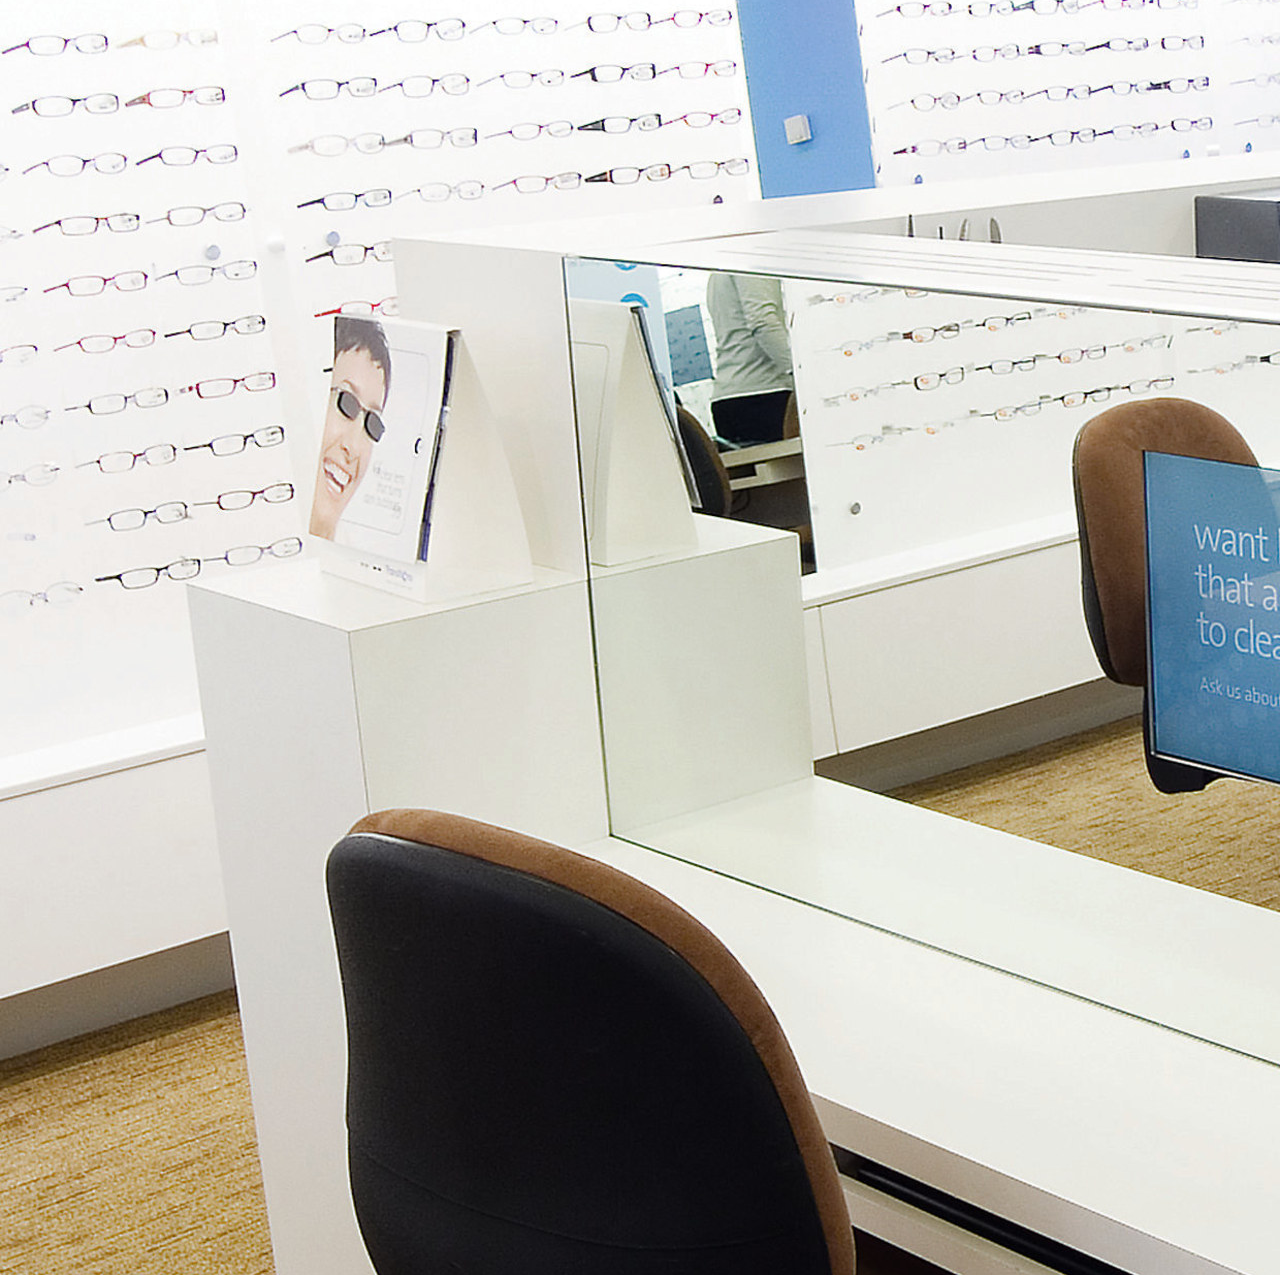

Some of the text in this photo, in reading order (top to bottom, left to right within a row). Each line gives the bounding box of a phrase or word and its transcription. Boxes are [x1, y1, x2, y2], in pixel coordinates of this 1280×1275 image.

[1193, 523, 1270, 562] want
[1194, 563, 1255, 608] that
[1196, 611, 1227, 648] to
[1199, 676, 1224, 696] Ask
[1226, 684, 1242, 700] us
